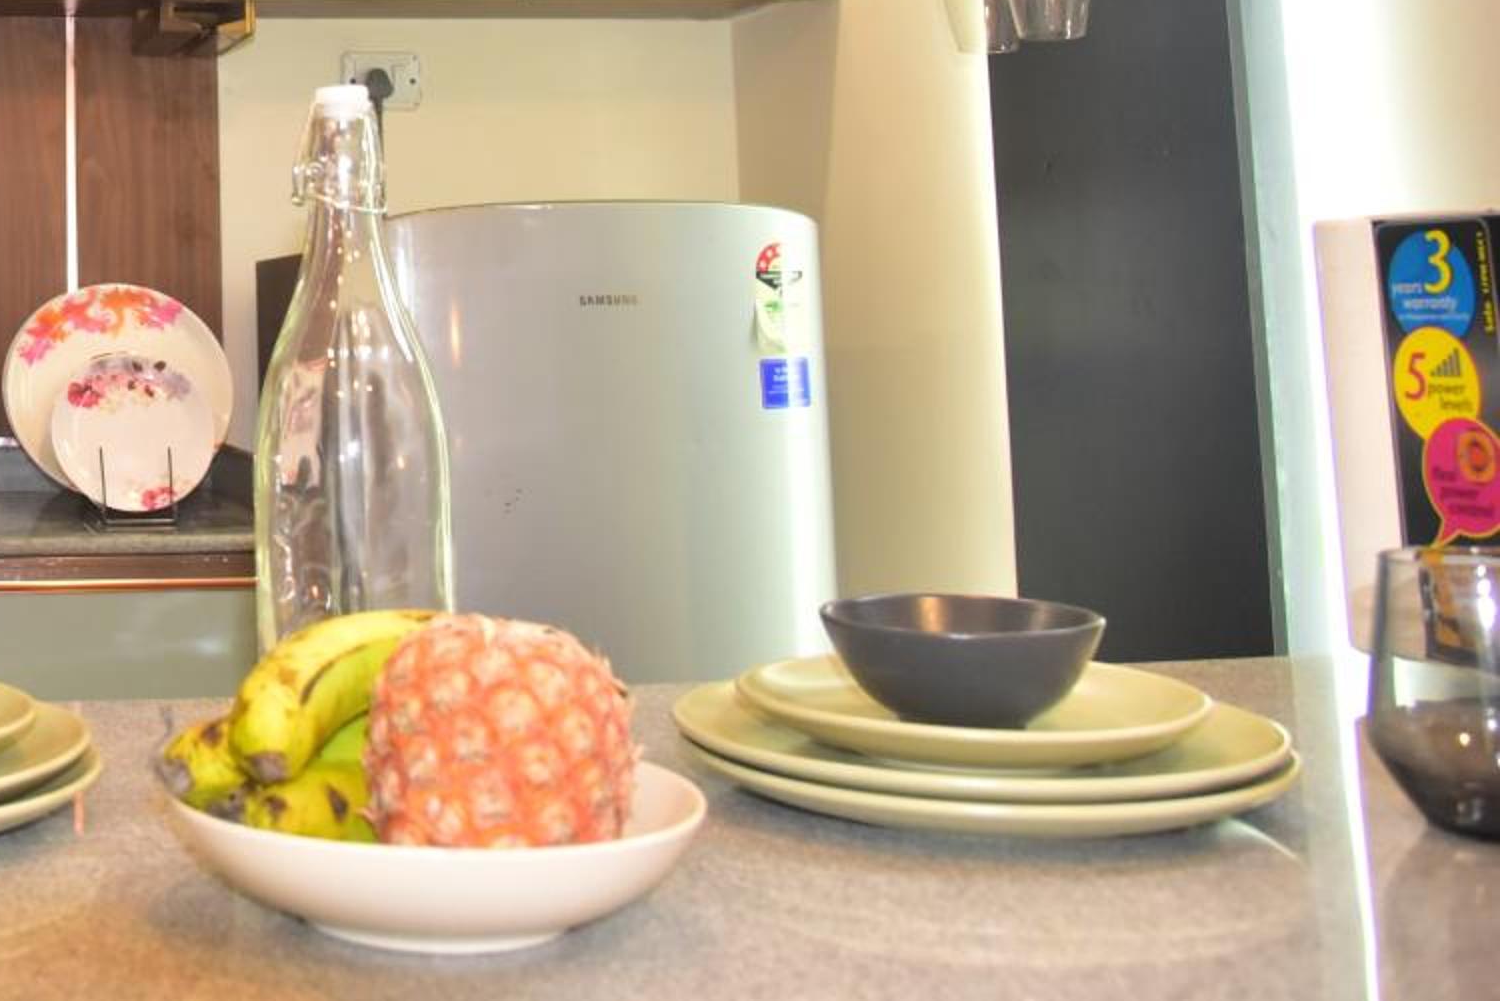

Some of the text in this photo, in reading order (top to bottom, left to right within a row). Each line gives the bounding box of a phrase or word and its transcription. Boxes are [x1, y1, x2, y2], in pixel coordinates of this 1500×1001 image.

[1423, 229, 1453, 295] 3
[579, 294, 638, 306] SAMSUNG
[1403, 297, 1458, 312] warranty
[1404, 351, 1427, 401] 5
[1428, 383, 1467, 399] power
